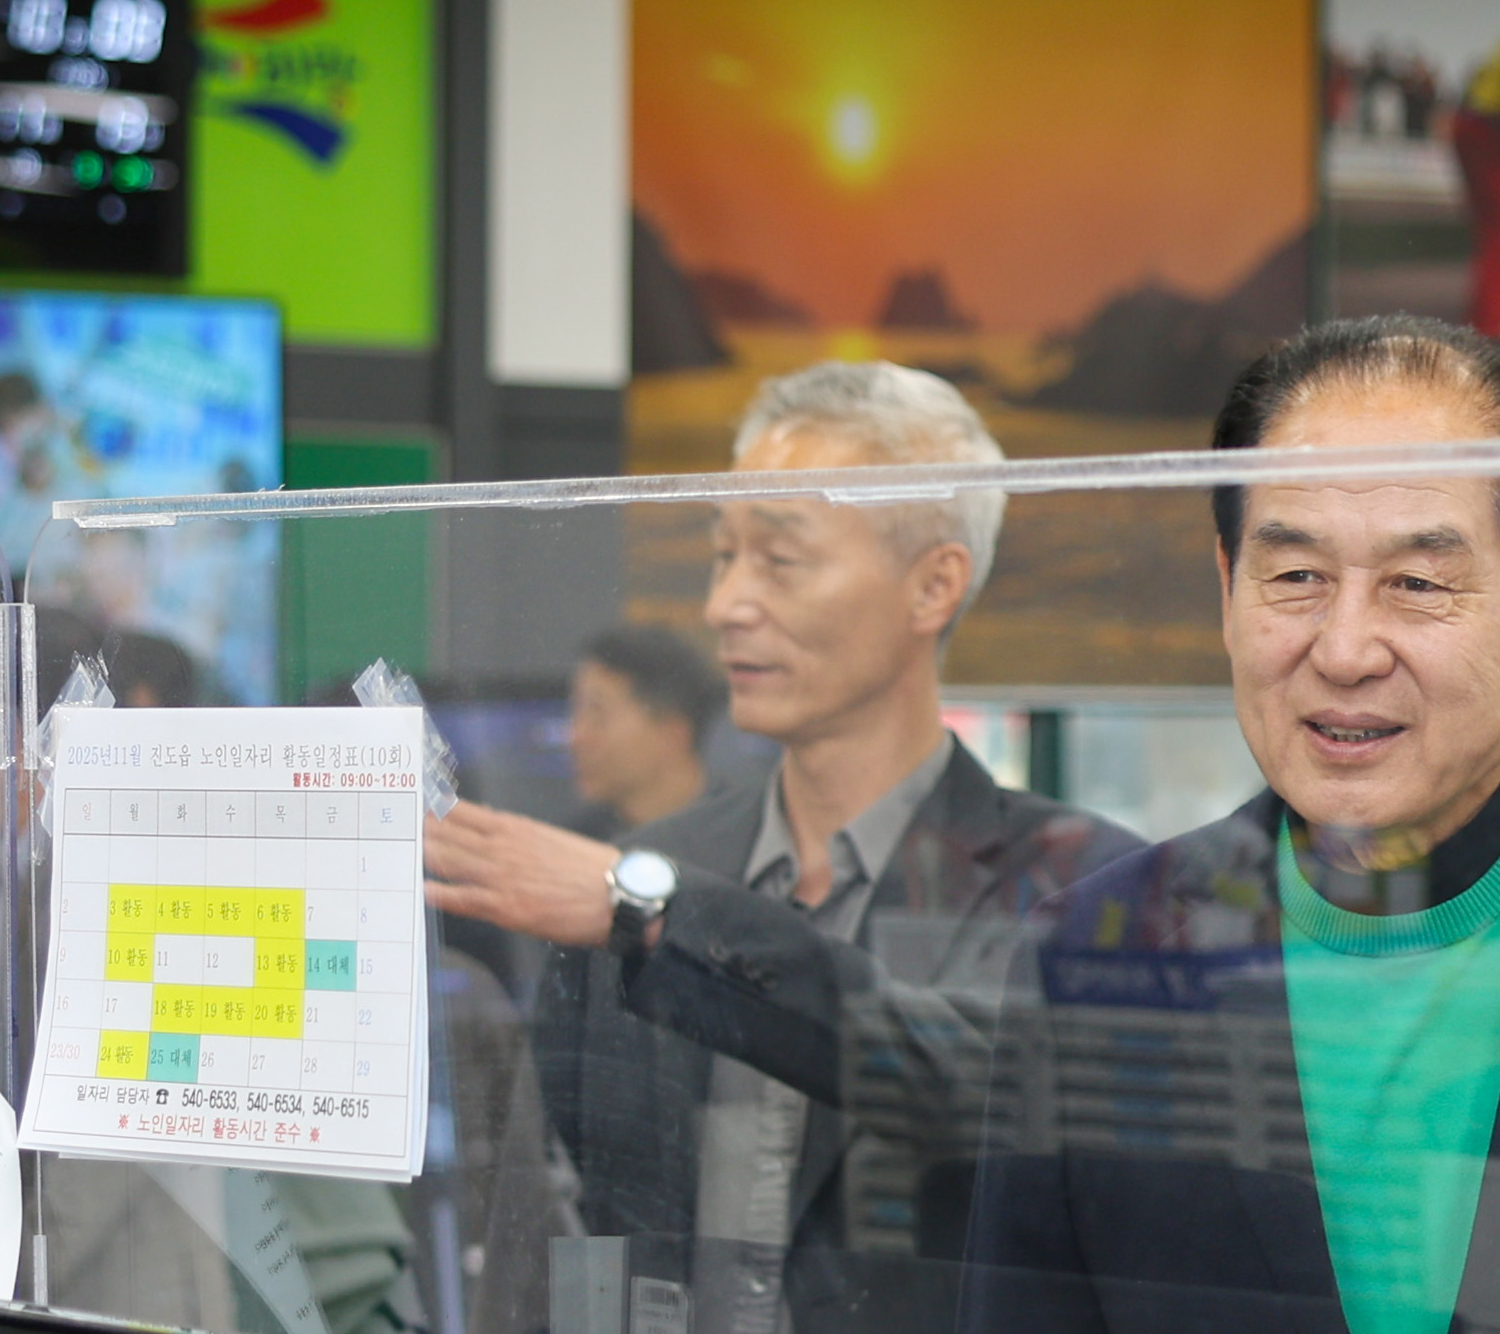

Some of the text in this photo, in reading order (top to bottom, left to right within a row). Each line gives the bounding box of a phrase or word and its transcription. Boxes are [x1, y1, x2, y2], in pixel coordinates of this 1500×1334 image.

[67, 744, 413, 769] 2025년11월 진도읍 노인일자리 활동일정표(10회)
[292, 772, 416, 788] 활동시간: 09:00~12:00
[81, 803, 92, 821] 일
[128, 804, 139, 821] 월
[176, 804, 187, 821] 화
[224, 805, 237, 823] 수
[275, 805, 287, 823] 목
[326, 806, 339, 824] 금
[380, 808, 393, 824] 토
[62, 899, 69, 914] 2
[109, 899, 143, 917] 3 활동
[158, 901, 192, 919] 4 활동
[207, 902, 242, 920] 5 활동
[257, 903, 292, 922] 6 활동
[308, 906, 314, 921] 7
[360, 908, 367, 923] 8
[59, 947, 66, 962] 9
[108, 948, 147, 967] 10 활동
[157, 951, 168, 966] 11
[206, 953, 218, 968] 12
[257, 954, 298, 973] 13 활동
[308, 956, 349, 975] 14 대체
[360, 959, 372, 974] 15
[56, 995, 69, 1010] 16
[105, 998, 117, 1012] 17
[154, 1000, 194, 1018] 18 활동
[204, 1002, 245, 1020] 19 활동
[255, 1004, 297, 1023] 20 활동
[307, 1008, 318, 1023] 21
[358, 1010, 372, 1025] 22
[50, 1044, 80, 1059] 23/30
[100, 1045, 133, 1064] 24 활동
[151, 1049, 191, 1067] 25 대체
[201, 1052, 214, 1067] 26
[252, 1055, 265, 1070] 27
[304, 1058, 317, 1073] 28
[357, 1061, 370, 1076] 29
[77, 1085, 369, 1118] 일자리 담당자 540-6533, 540-6534, 540-6515
[137, 1114, 301, 1144] 노인일자리 활동시간 준수
